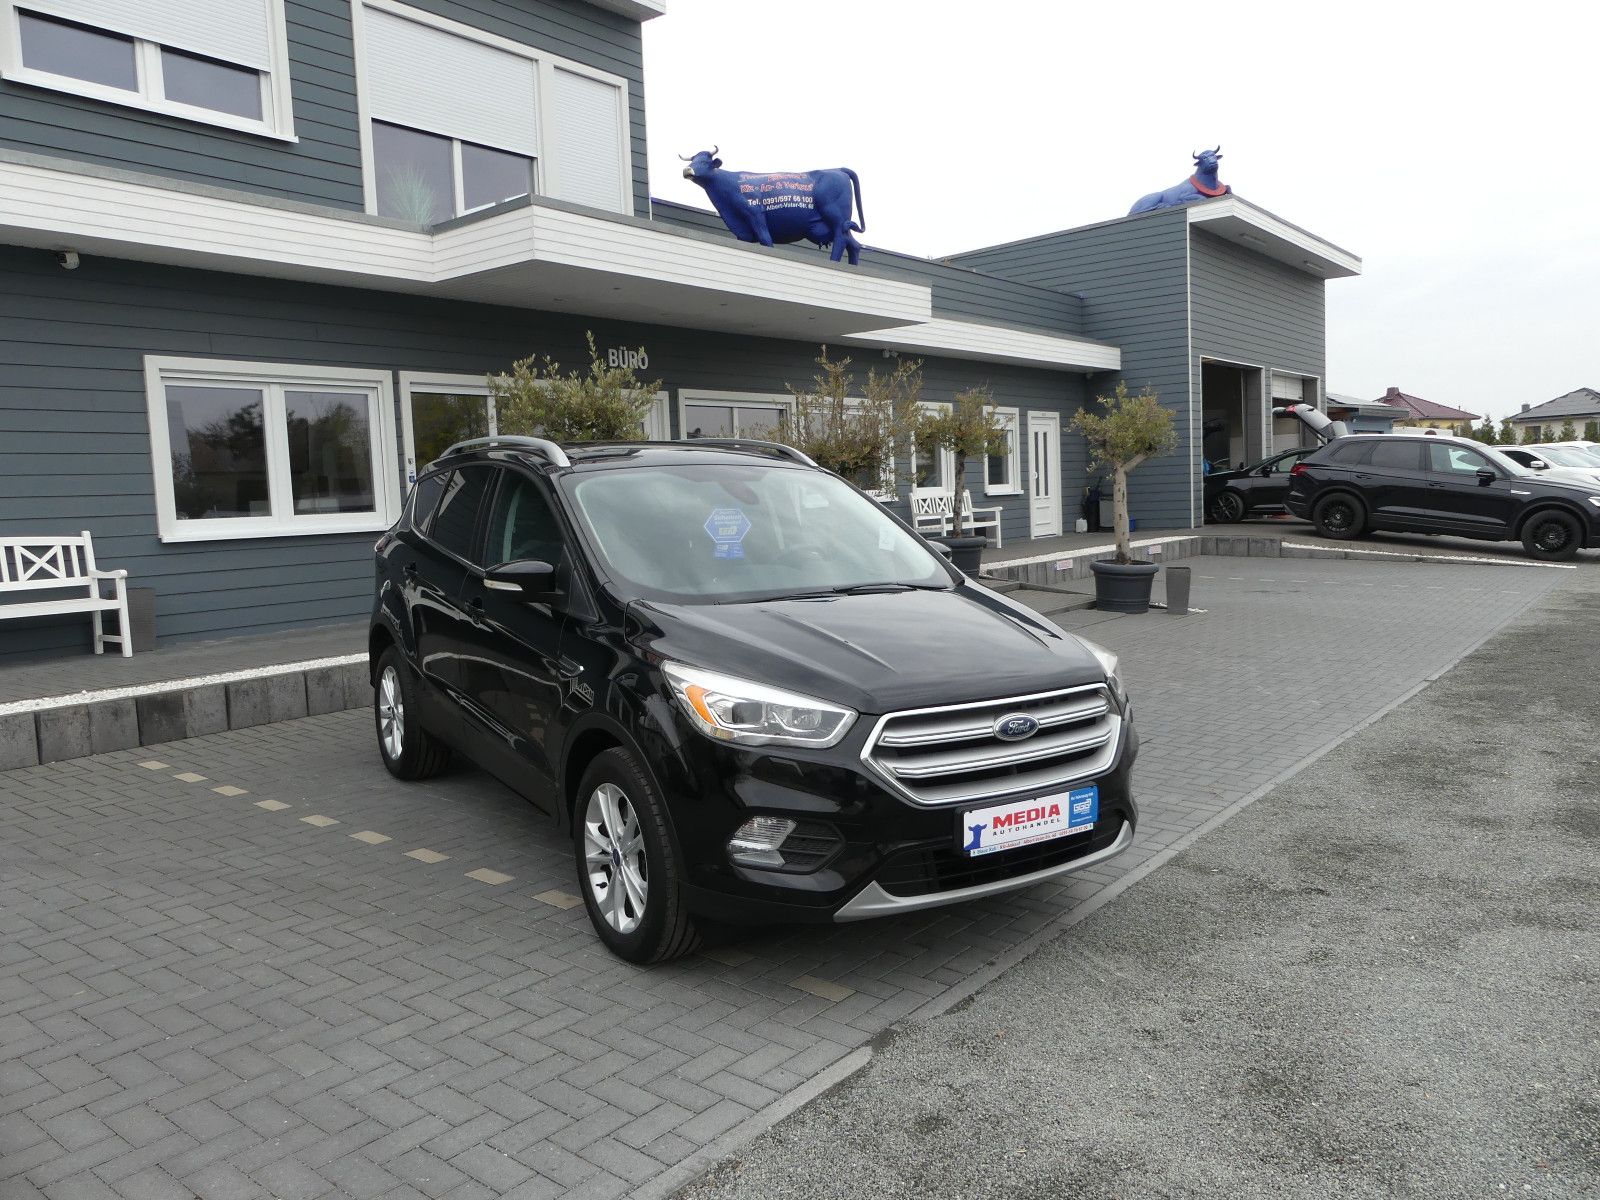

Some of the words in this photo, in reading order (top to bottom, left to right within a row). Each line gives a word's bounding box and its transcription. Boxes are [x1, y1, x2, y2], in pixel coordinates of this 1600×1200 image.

[748, 198, 760, 206] Tel.
[802, 196, 813, 204] 100
[608, 346, 649, 370] BÜRO
[1007, 719, 1030, 734] Ford
[992, 803, 1061, 829] MEDIA
[993, 817, 1060, 836] AUTOHANDEL
